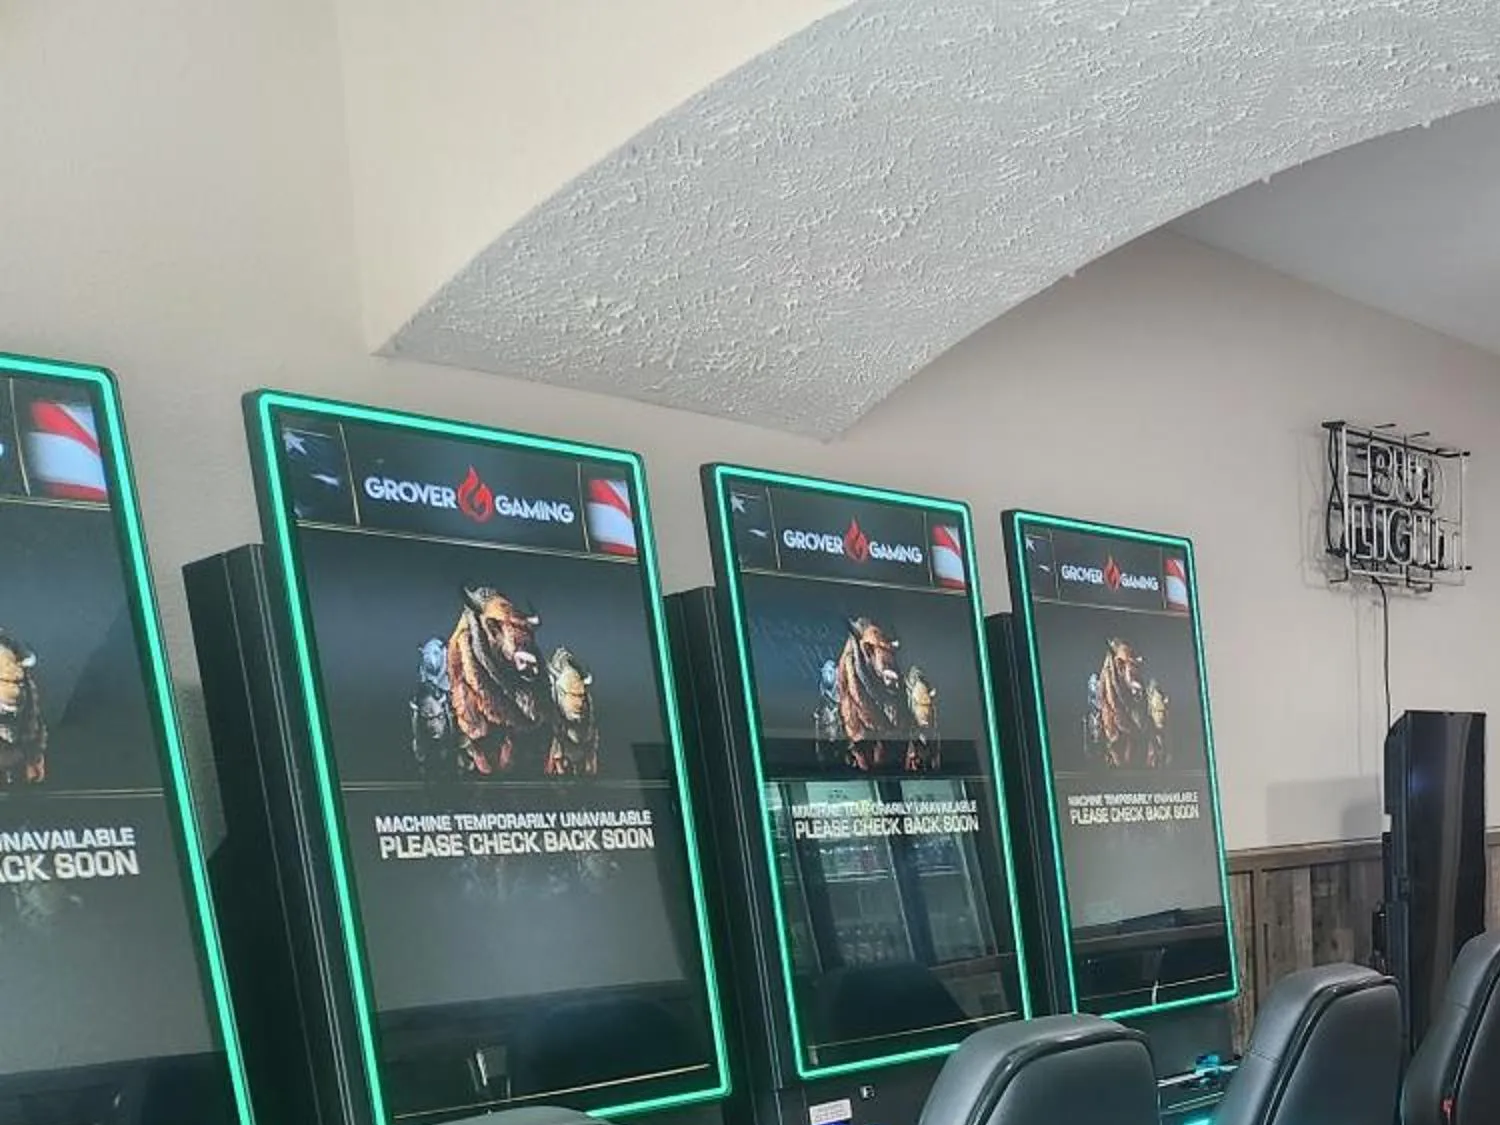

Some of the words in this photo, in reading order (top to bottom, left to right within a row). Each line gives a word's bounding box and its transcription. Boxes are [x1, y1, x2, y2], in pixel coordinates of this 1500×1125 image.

[1367, 442, 1447, 510] BUD
[364, 476, 458, 509] GROVER
[494, 495, 575, 524] GAMING
[783, 529, 844, 555] GROVER
[868, 541, 923, 564] GAMING
[1061, 564, 1104, 585] GROVER
[1120, 573, 1159, 591] GAMING
[375, 815, 452, 833] MACHINE
[454, 811, 556, 831] TEMPORARILY
[560, 809, 652, 828] UNAVAILABLE
[795, 817, 849, 839] PLEASE
[852, 816, 902, 837] CHECK
[903, 814, 942, 834] BACK
[943, 814, 980, 832] SOON
[0, 826, 136, 853] NAVAILABLE
[380, 834, 465, 859] PLEASE
[469, 831, 541, 855] CHECK
[544, 829, 599, 852] BACK
[602, 827, 655, 850] SOON
[0, 853, 51, 883] CK
[54, 849, 140, 879] SOON
